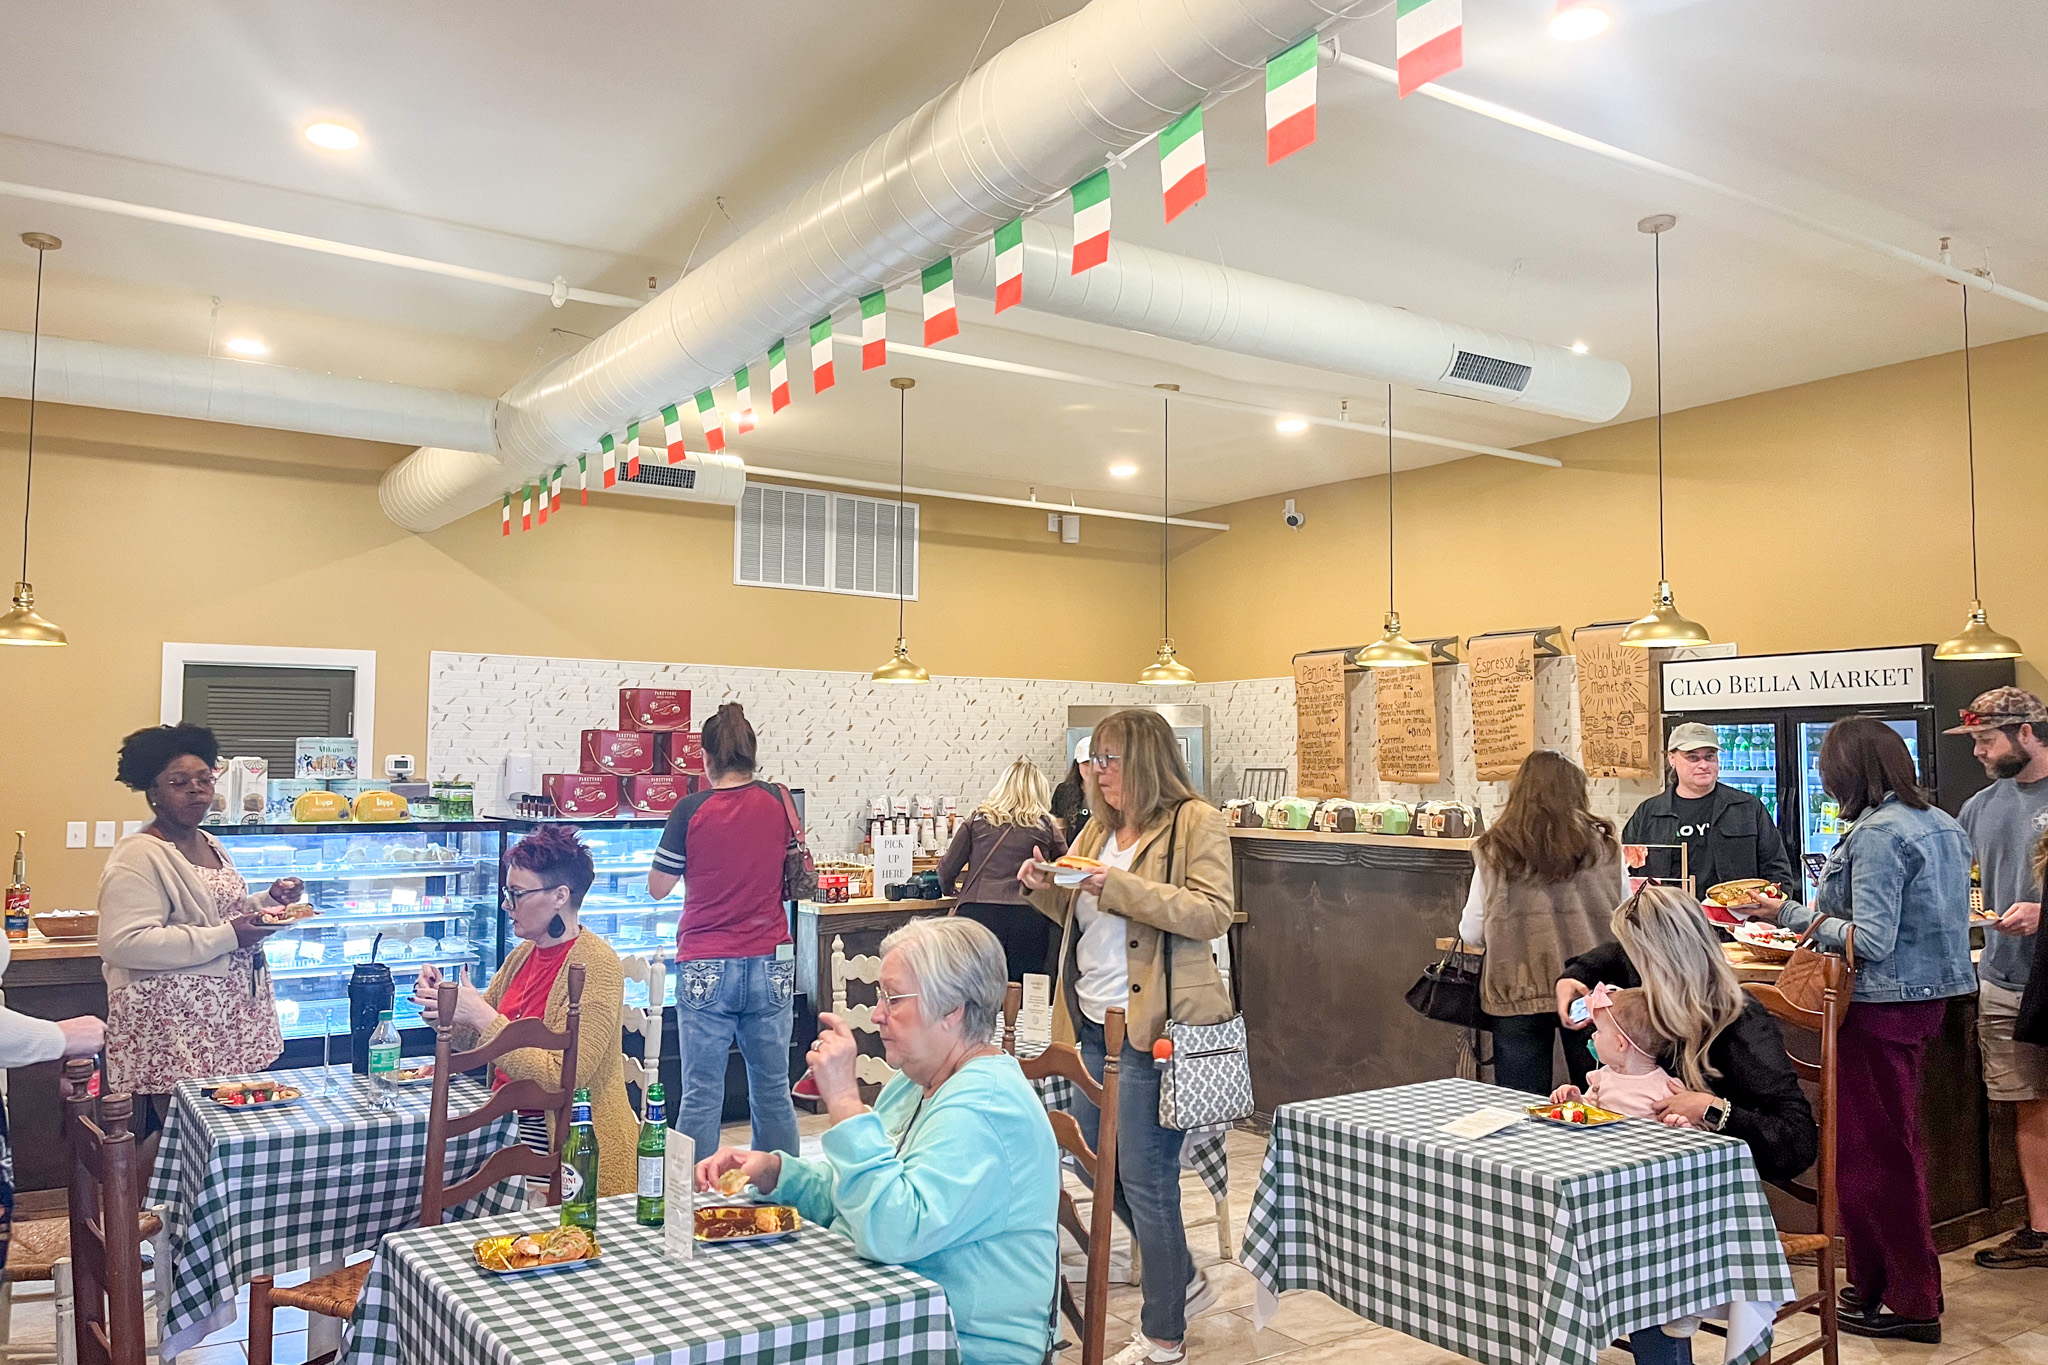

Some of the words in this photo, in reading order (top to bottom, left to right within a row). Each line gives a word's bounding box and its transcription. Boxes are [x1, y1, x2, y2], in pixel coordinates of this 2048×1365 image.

[1303, 665, 1328, 680] Panini
[1475, 657, 1514, 674] Espresso
[1587, 661, 1609, 680] Ciao
[1611, 657, 1631, 677] Bella
[1591, 680, 1619, 694] Market
[1670, 678, 1721, 697] CIAO
[1729, 675, 1801, 694] BELLA
[1809, 667, 1914, 690] MARKET
[884, 839, 904, 849] PICK
[888, 854, 900, 863] UP
[881, 869, 905, 879] HERE
